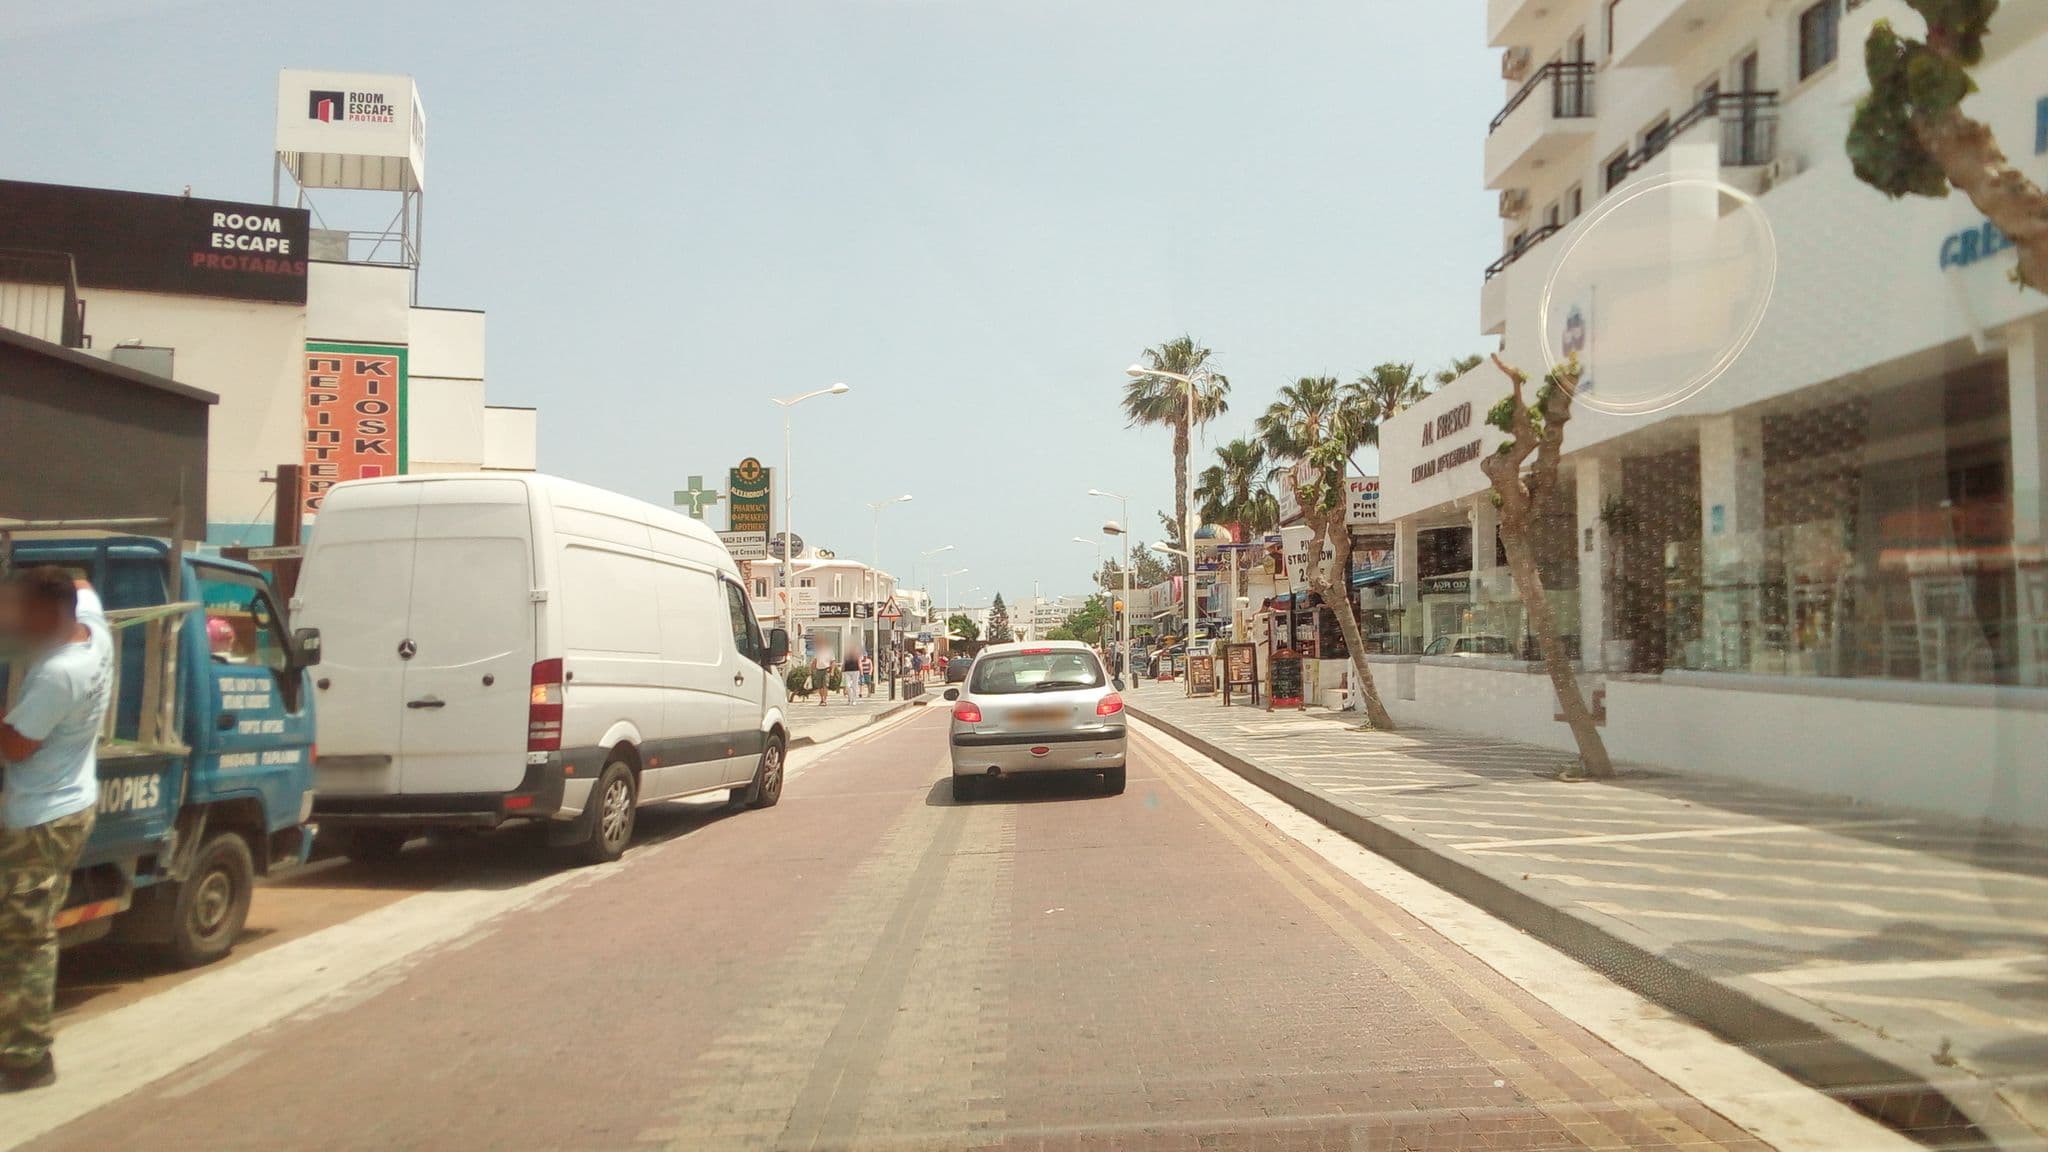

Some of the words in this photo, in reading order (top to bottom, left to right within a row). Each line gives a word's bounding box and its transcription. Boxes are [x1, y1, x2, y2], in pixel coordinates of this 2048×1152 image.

[349, 92, 384, 104] ROOM
[349, 103, 394, 116] ESCAPE
[348, 114, 394, 123] PROTARAS
[212, 212, 281, 233] ROOM
[211, 232, 290, 255] ESCAPE
[191, 252, 306, 276] PROTARAS
[355, 360, 392, 455] KIOSK
[1422, 421, 1434, 448] AL
[1436, 401, 1471, 440] FRESCO
[733, 504, 767, 512] PHARMACY
[740, 548, 765, 556] Crossing
